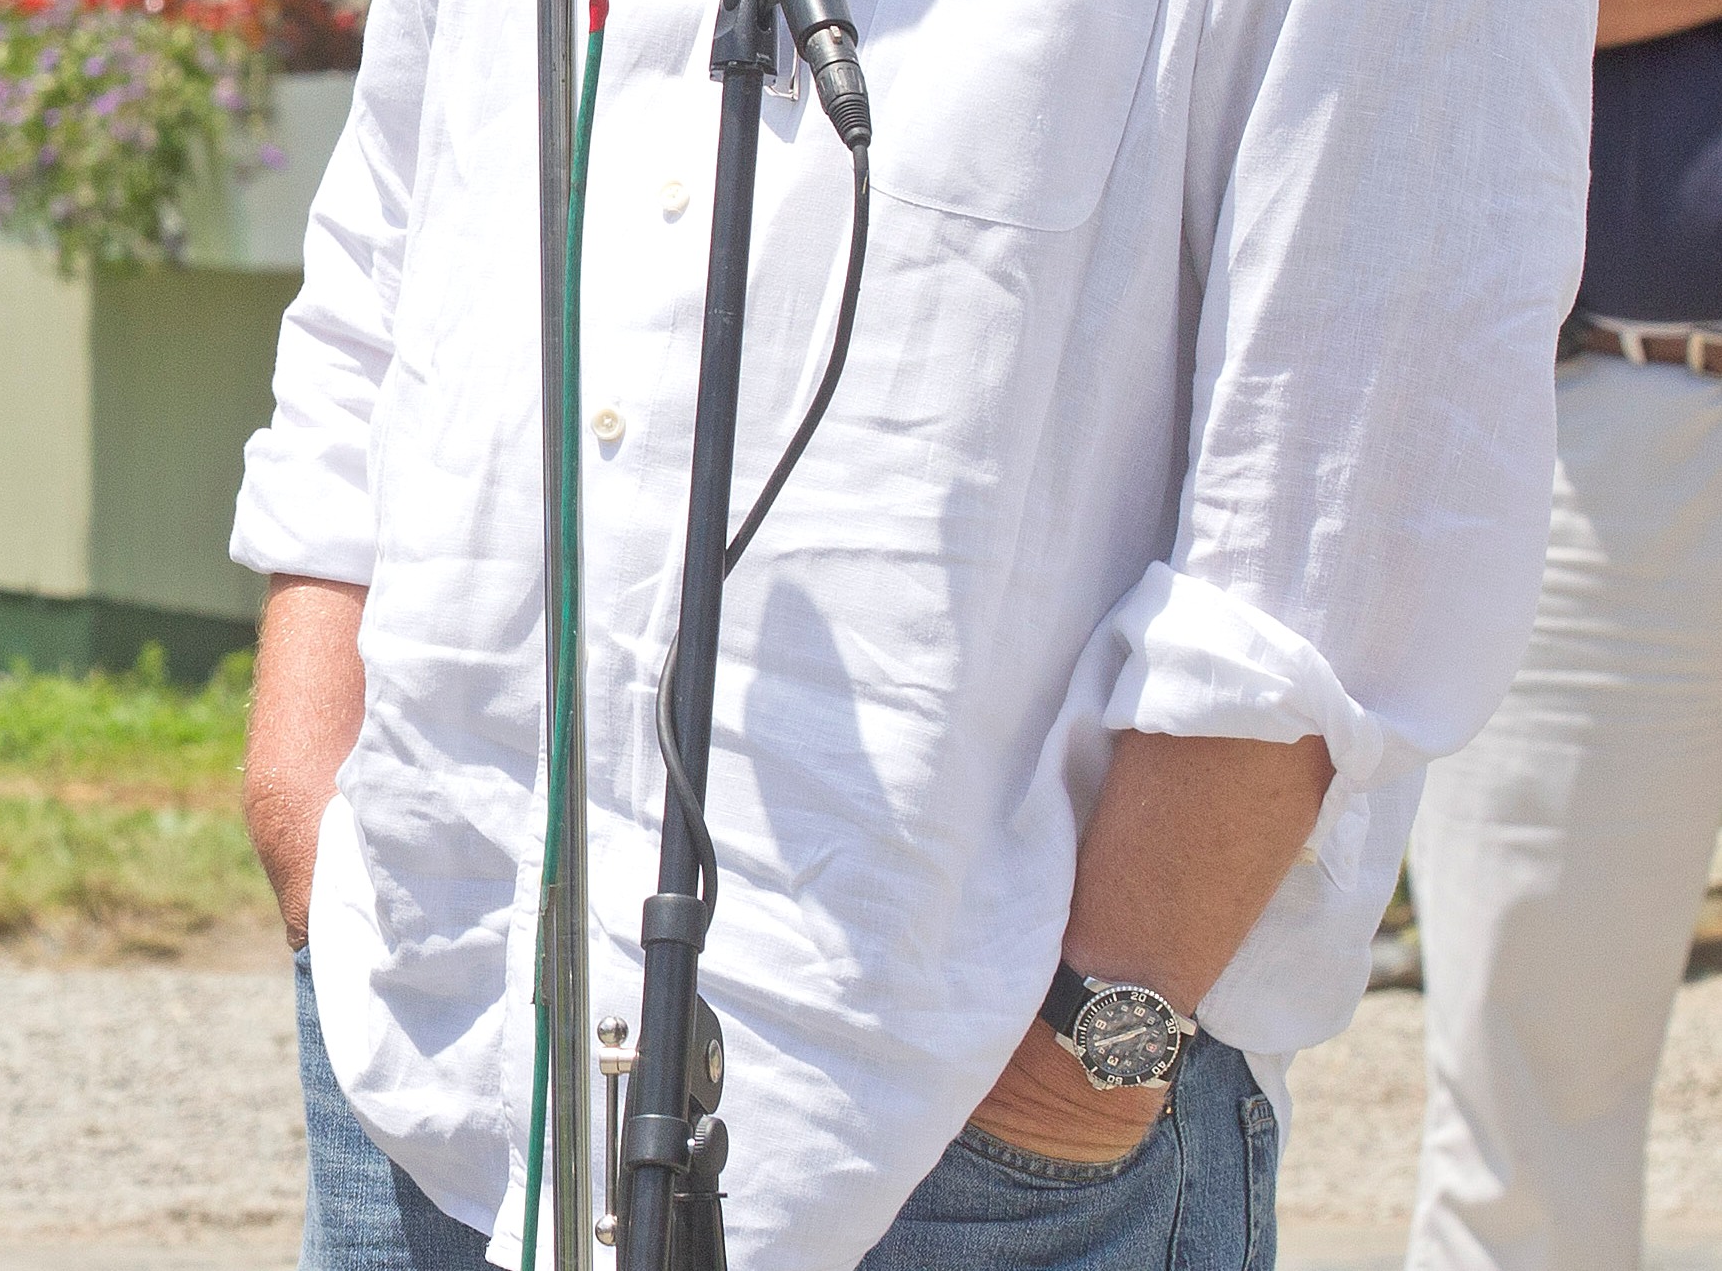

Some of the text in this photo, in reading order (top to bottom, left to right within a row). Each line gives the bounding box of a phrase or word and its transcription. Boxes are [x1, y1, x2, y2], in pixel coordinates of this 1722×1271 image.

[1130, 992, 1147, 1003] 20
[1165, 1018, 1177, 1035] 30
[1107, 1055, 1119, 1066] 3
[1151, 1061, 1166, 1074] 40
[1107, 1075, 1123, 1085] 50
